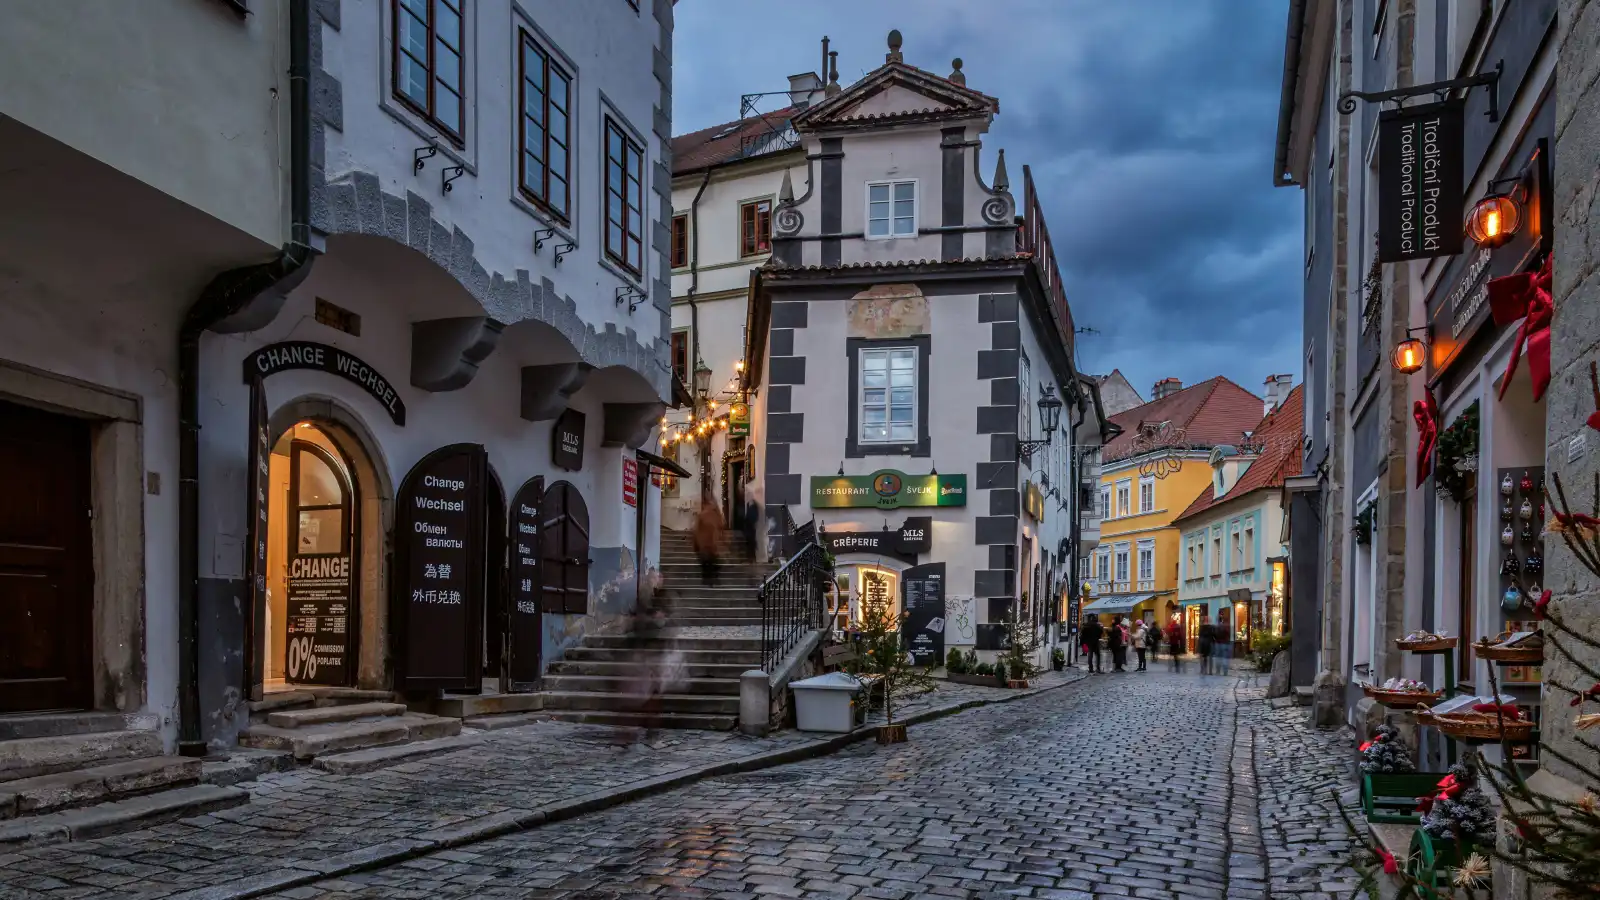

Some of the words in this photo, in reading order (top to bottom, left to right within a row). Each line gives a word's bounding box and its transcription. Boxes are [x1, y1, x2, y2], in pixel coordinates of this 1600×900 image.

[1424, 117, 1441, 184] Tradiční
[1401, 122, 1415, 196] Traditional
[1401, 199, 1415, 254] Product
[1424, 187, 1441, 251] Produkt
[256, 346, 325, 373] CHANGE
[336, 353, 396, 414] WECHSEL
[562, 431, 579, 446] MLS
[424, 475, 465, 491] Change
[816, 487, 870, 495] RESTAURANT
[906, 485, 932, 494] ŠVEJK
[415, 496, 464, 512] Wechsel
[521, 504, 537, 517] Change
[414, 521, 447, 535] Обмен
[903, 529, 924, 537] MLS
[425, 538, 463, 549] валюты
[833, 536, 879, 547] CRÊPERIE
[291, 557, 349, 578] CHANGE
[424, 563, 452, 580] 為替
[412, 588, 461, 605] 外币兑换
[314, 644, 345, 653] COMMISSION
[288, 636, 317, 680] 0%
[316, 657, 342, 666] POPLATEK
